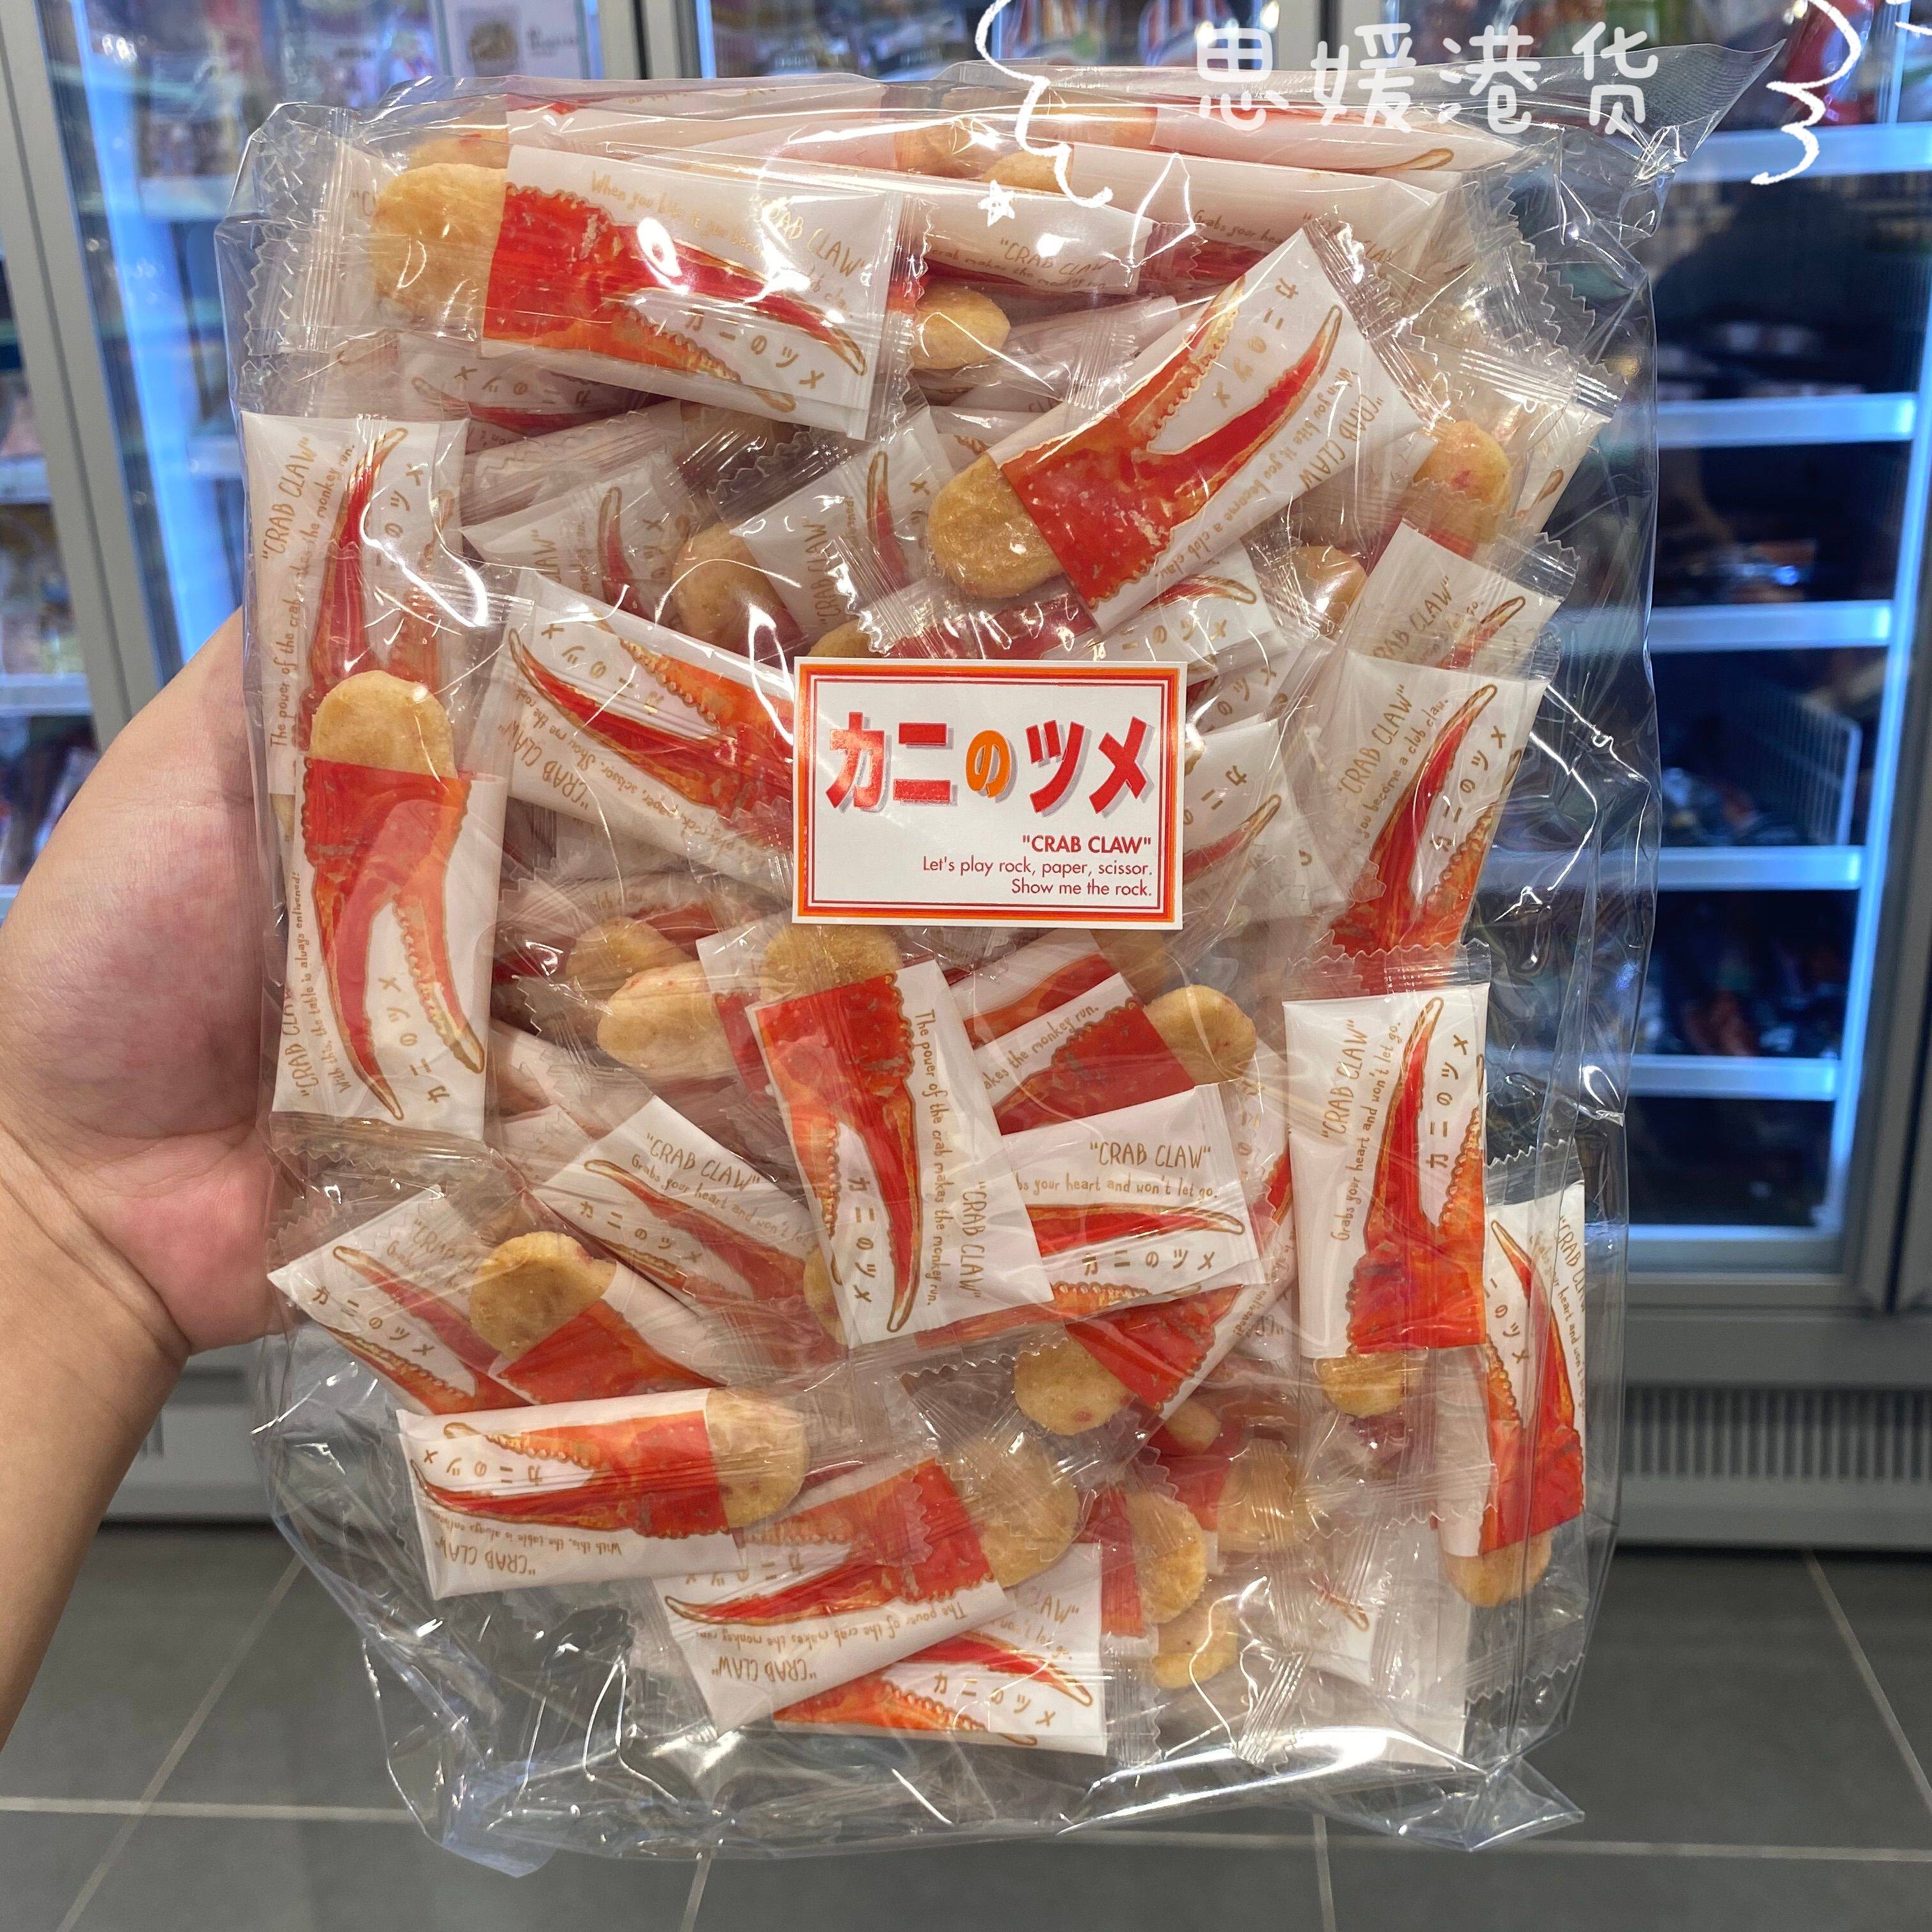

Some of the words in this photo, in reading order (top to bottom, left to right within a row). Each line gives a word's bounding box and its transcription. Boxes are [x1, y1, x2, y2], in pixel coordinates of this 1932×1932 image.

[1000, 238, 1054, 268] "CRAB
[1260, 231, 1285, 244] hea
[1215, 278, 1299, 408] カニのツメ
[262, 503, 294, 562] "CRAB
[279, 436, 317, 499] CLAW"
[316, 471, 340, 519] monkey
[1225, 484, 1271, 521] become
[1409, 575, 1452, 632] CLAW"
[276, 633, 297, 653] the
[1208, 668, 1277, 730] のツメ
[1372, 684, 1413, 744] CLAW"
[269, 720, 287, 748] The
[825, 711, 1152, 816] カニのツメ
[1363, 770, 1401, 812] become
[1399, 756, 1408, 766] a
[1404, 726, 1426, 755] club
[1422, 700, 1449, 727] claw.
[542, 761, 588, 809] "CRAB
[601, 761, 638, 793] scissor.
[1022, 834, 1082, 854] "CRAB
[1087, 835, 1151, 854] CLAW"
[923, 856, 956, 873] Let's
[960, 856, 993, 877] play
[999, 857, 1036, 876] rock,
[1041, 862, 1092, 878] paper,
[1098, 859, 1153, 876] scissor.
[293, 871, 305, 929] enlivened!
[1011, 877, 1054, 895] Show
[1058, 883, 1082, 896] me
[1087, 879, 1111, 896] the
[1115, 879, 1152, 897] rock.
[295, 933, 310, 971] always
[302, 973, 312, 983] is
[300, 986, 321, 1015] table
[378, 976, 450, 1103] カニのツメ
[914, 1009, 935, 1037] The
[915, 1041, 935, 1078] power
[983, 1068, 1009, 1090] akes
[1007, 1048, 1030, 1070] the
[1032, 1016, 1075, 1055] monkey
[1075, 1006, 1100, 1027] run.
[1337, 1019, 1368, 1080] CLAW"
[1377, 1044, 1393, 1066] let
[286, 1043, 319, 1097] "CRAB
[1368, 1068, 1390, 1104] won't
[922, 1082, 949, 1101] of
[1426, 1033, 1469, 1169] カニのツメ
[930, 1103, 949, 1124] the
[1321, 1086, 1354, 1138] "CRAB
[1363, 1106, 1377, 1135] and
[932, 1128, 953, 1158] crab
[1090, 1141, 1147, 1167] "CRAB
[1155, 1144, 1211, 1169] CLAW"
[1353, 1136, 1370, 1173] heart
[647, 1133, 696, 1170] "CRAB
[700, 1159, 761, 1192] CLAW"
[631, 1154, 661, 1183] Grabs
[661, 1176, 690, 1194] your
[694, 1185, 727, 1210] heart
[934, 1162, 955, 1203] makes
[1034, 1179, 1060, 1197] your
[1066, 1172, 1101, 1192] heart
[1107, 1175, 1131, 1192] and
[1136, 1175, 1170, 1195] won't
[1177, 1179, 1194, 1198] let
[1345, 1176, 1361, 1205] your
[933, 1207, 954, 1230] the
[962, 1180, 989, 1238] "CRAB
[1330, 1204, 1354, 1242] Grabs
[579, 1200, 703, 1264] カニのツメ
[847, 1176, 875, 1304] カニのツメ
[924, 1236, 947, 1278] monkey
[958, 1244, 986, 1301] CLAW"
[1081, 1248, 1215, 1276] カニのツメ
[926, 1282, 937, 1307] run.
[1558, 1286, 1574, 1321] heart
[424, 1450, 542, 1486] カニのツメ
[485, 1550, 537, 1576] "CRAB
[595, 1542, 623, 1556] With
[940, 1600, 969, 1620] The
[768, 1634, 788, 1653] the
[790, 1632, 829, 1652] makes
[831, 1629, 860, 1648] crab
[864, 1621, 883, 1641] the
[711, 1656, 760, 1680] CLAW"
[766, 1657, 817, 1682] "CRAB
